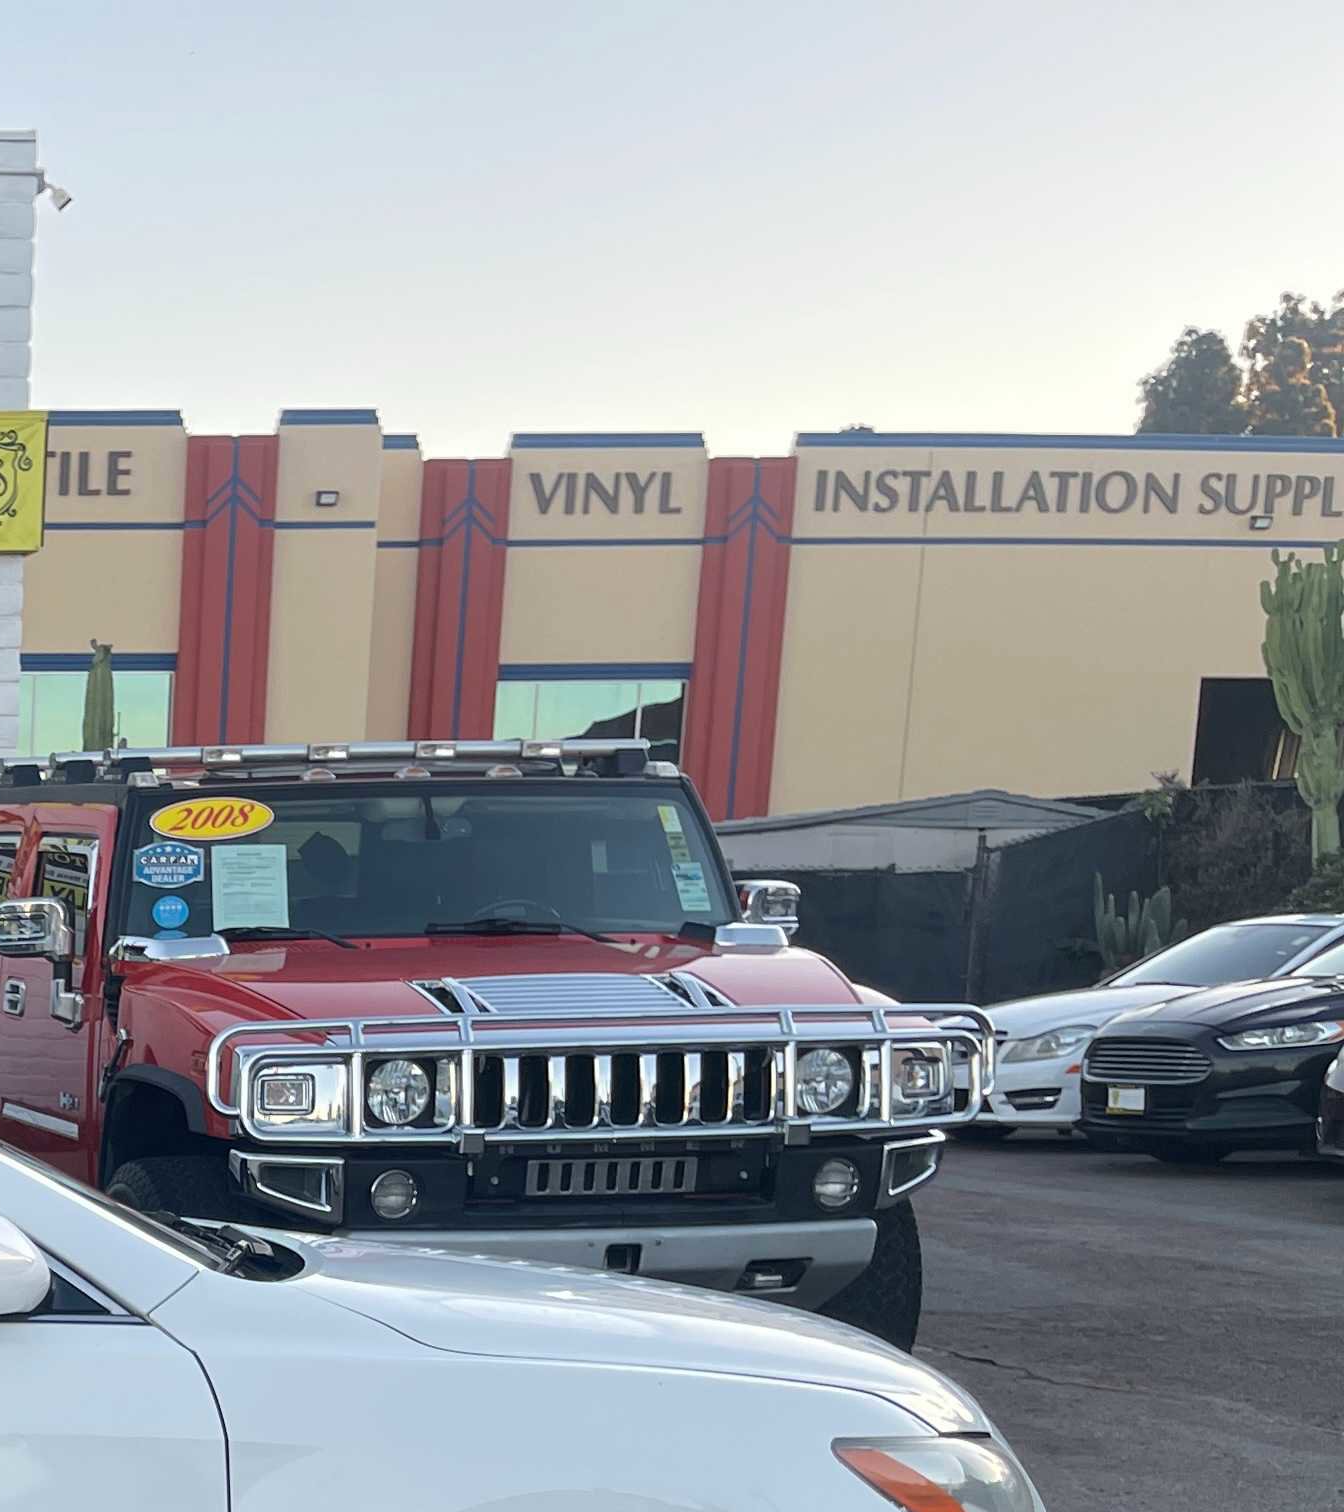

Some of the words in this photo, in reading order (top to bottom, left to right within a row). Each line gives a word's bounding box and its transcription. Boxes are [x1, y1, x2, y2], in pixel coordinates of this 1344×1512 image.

[530, 472, 682, 515] VINYL
[814, 470, 1180, 514] INSTALLATION
[1198, 472, 1343, 517] SUPPL
[168, 802, 255, 832] 2008
[140, 854, 199, 865] CARFAX
[143, 866, 194, 875] ADVANTAGE
[151, 874, 186, 884] DEALER
